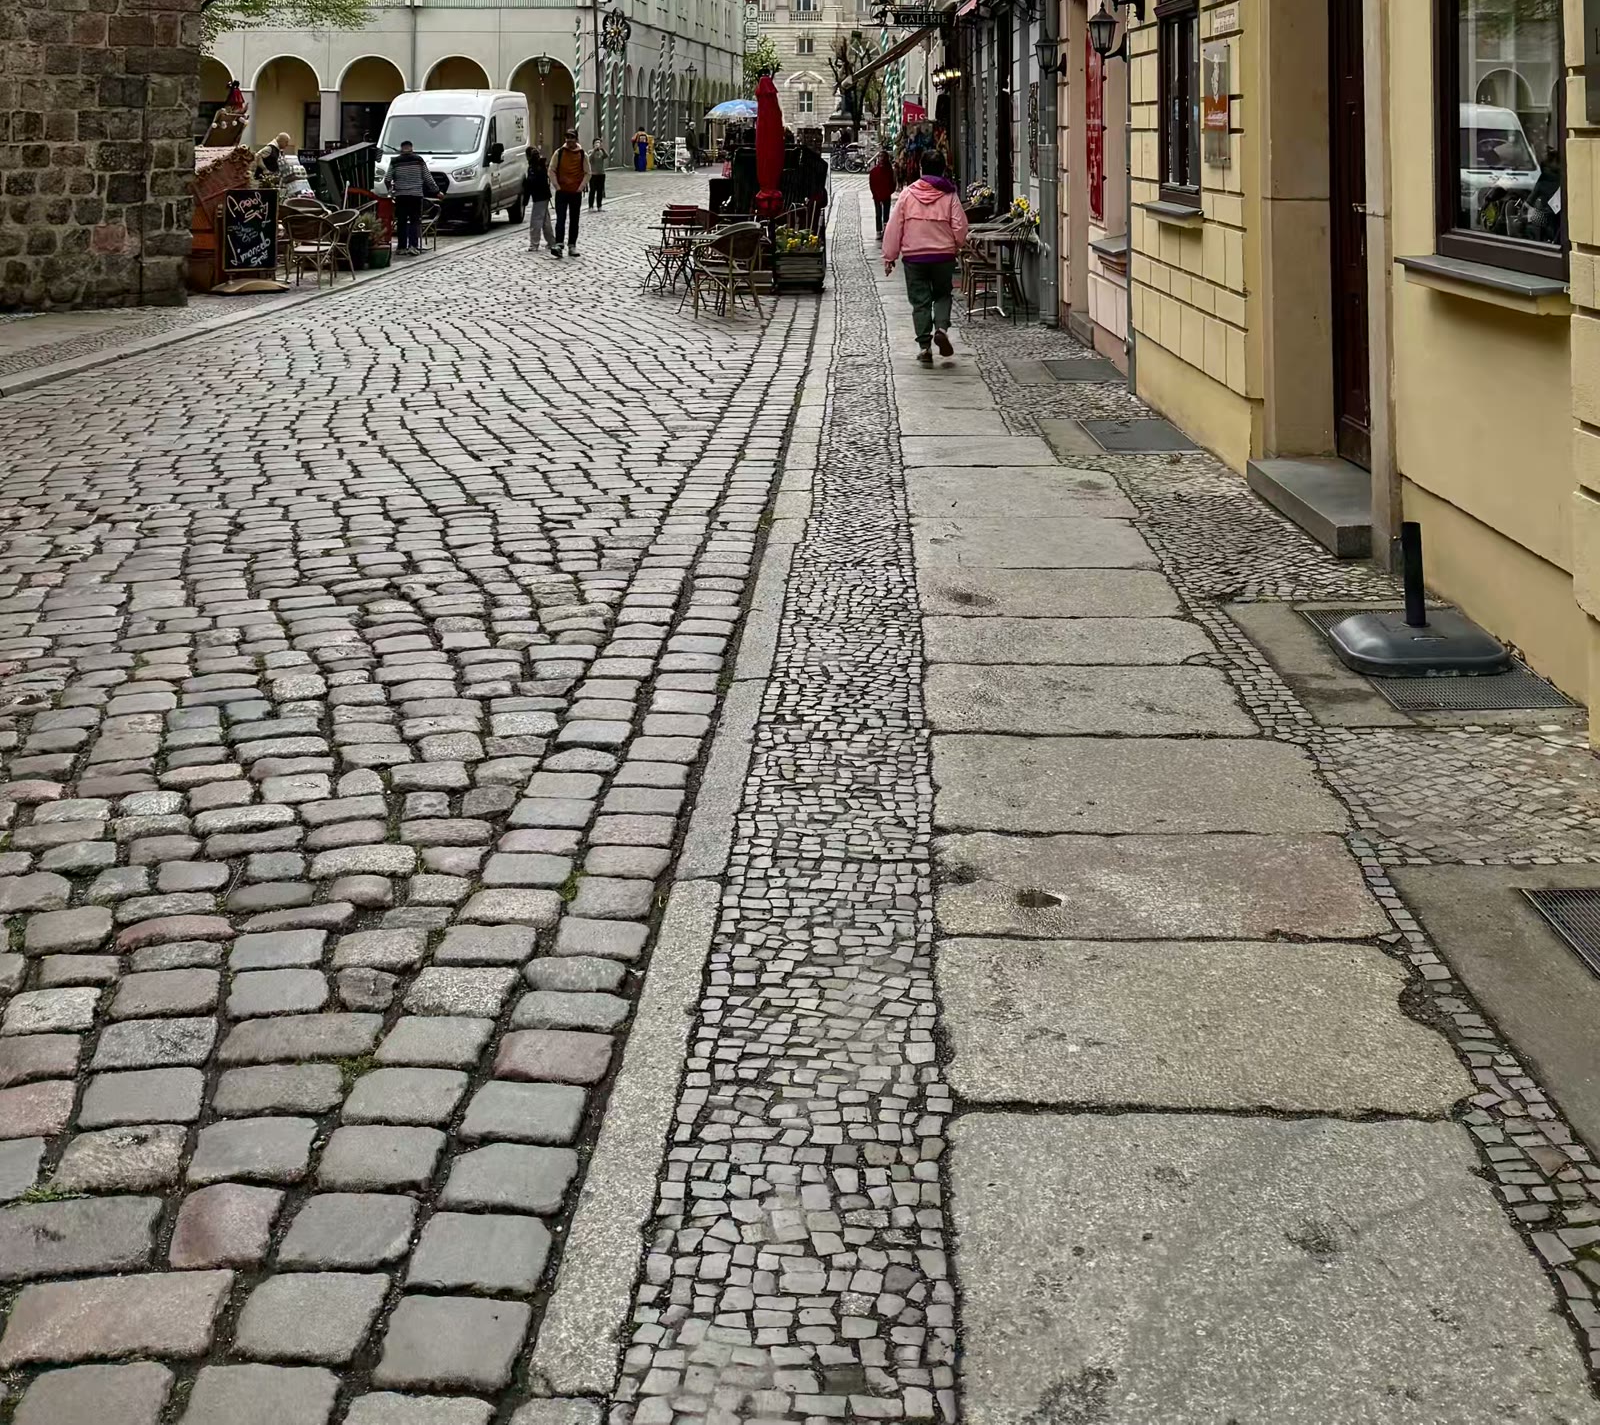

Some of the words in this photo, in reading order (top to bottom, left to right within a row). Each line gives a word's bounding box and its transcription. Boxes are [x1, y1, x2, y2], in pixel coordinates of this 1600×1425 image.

[900, 14, 948, 24] GALERIE
[907, 113, 927, 122] EIS
[226, 191, 264, 217] Aperol
